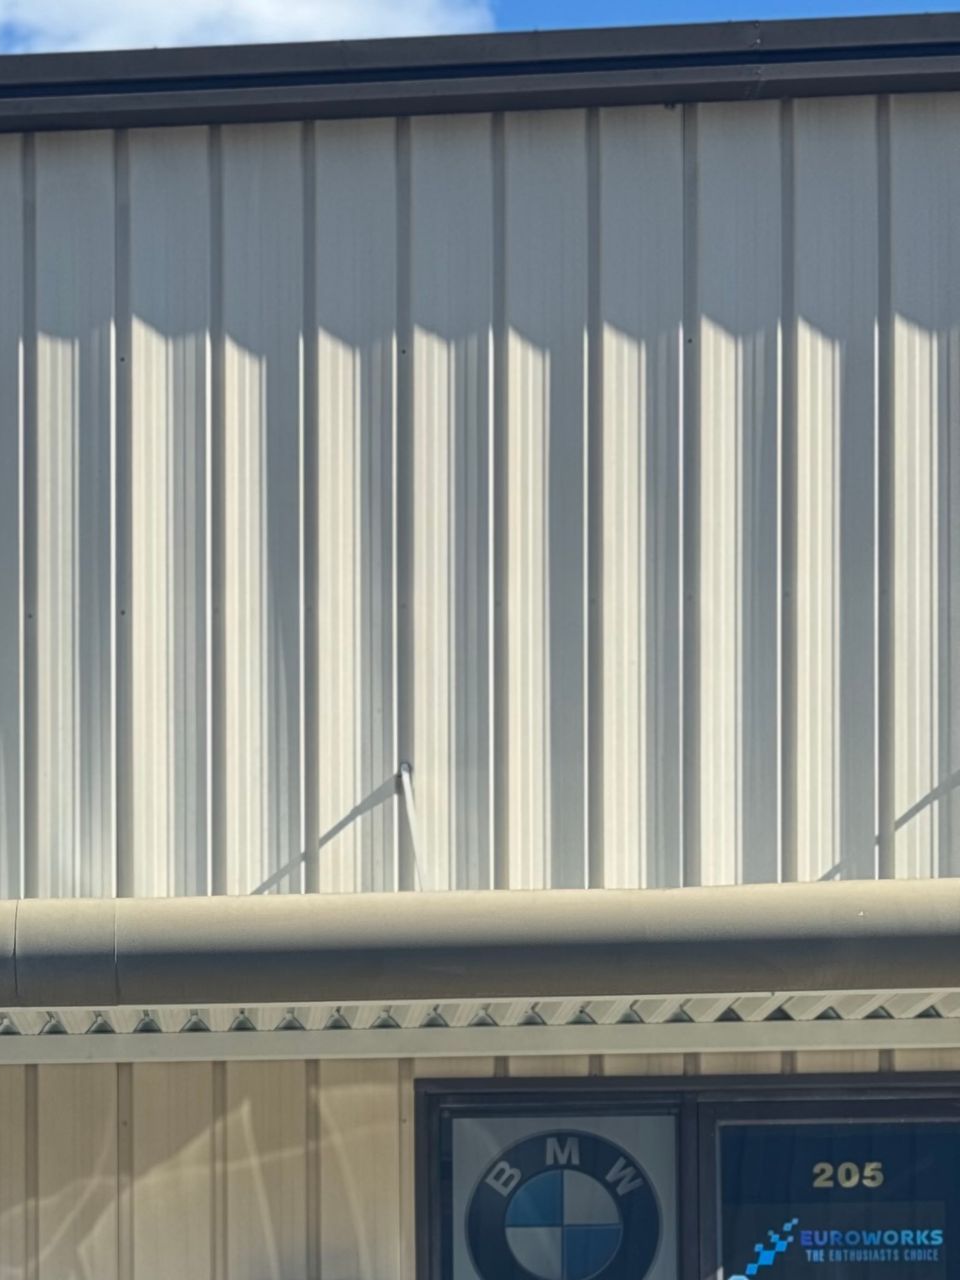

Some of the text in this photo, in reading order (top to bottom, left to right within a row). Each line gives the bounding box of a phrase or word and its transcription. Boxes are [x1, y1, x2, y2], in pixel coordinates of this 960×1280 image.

[485, 1137, 645, 1197] BMW
[812, 1162, 884, 1188] 205
[799, 1229, 944, 1246] EUROWORKS
[806, 1249, 939, 1262] THE ENTHUSIASTS CHOICE
